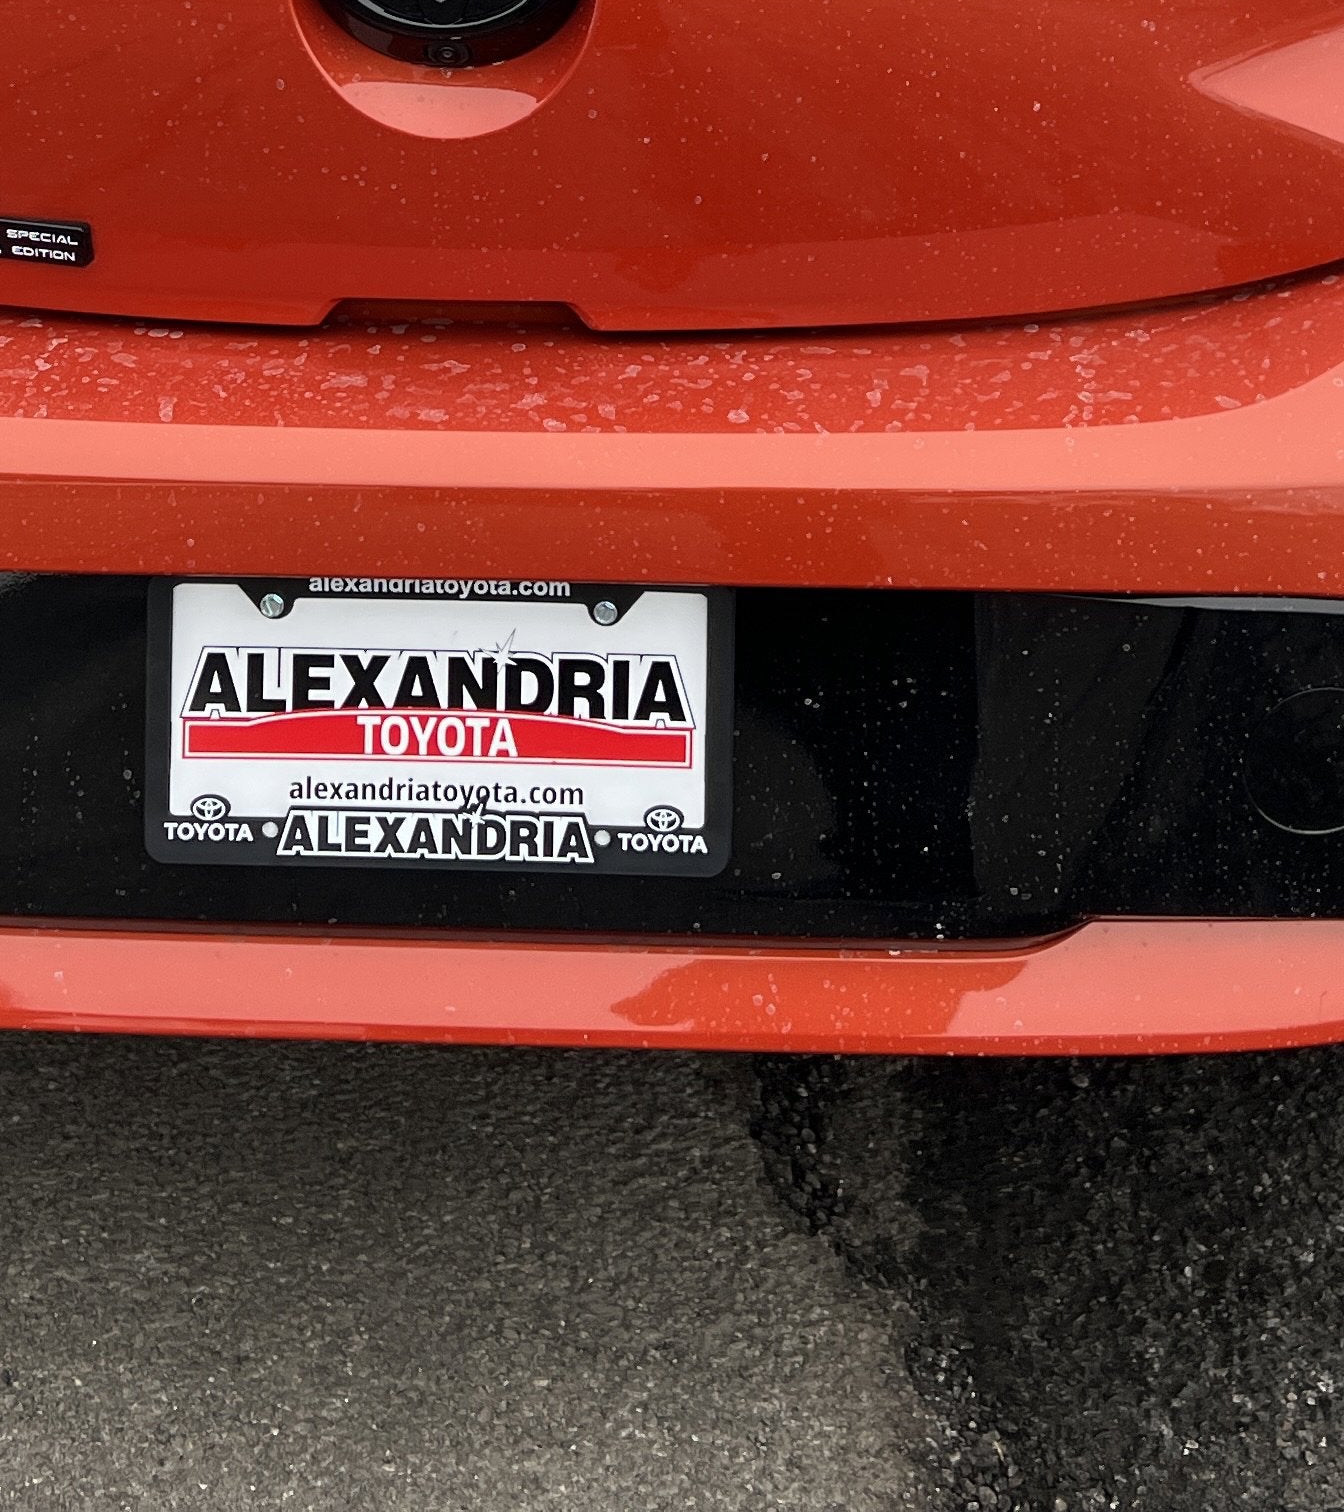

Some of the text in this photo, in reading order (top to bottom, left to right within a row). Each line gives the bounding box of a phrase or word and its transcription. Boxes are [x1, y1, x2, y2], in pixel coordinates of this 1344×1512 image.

[6, 228, 78, 245] SPECIAL
[11, 245, 76, 261] EDITION
[308, 576, 572, 599] alexandriatoyota.com
[188, 651, 688, 723] ALEXANDRIA
[356, 714, 518, 758] TOYOTA
[289, 776, 584, 808] alexandriatoyota.com
[163, 821, 254, 842] TOYOTA
[279, 811, 592, 862] ALEXANDRIA
[617, 832, 708, 854] TOYOTA
